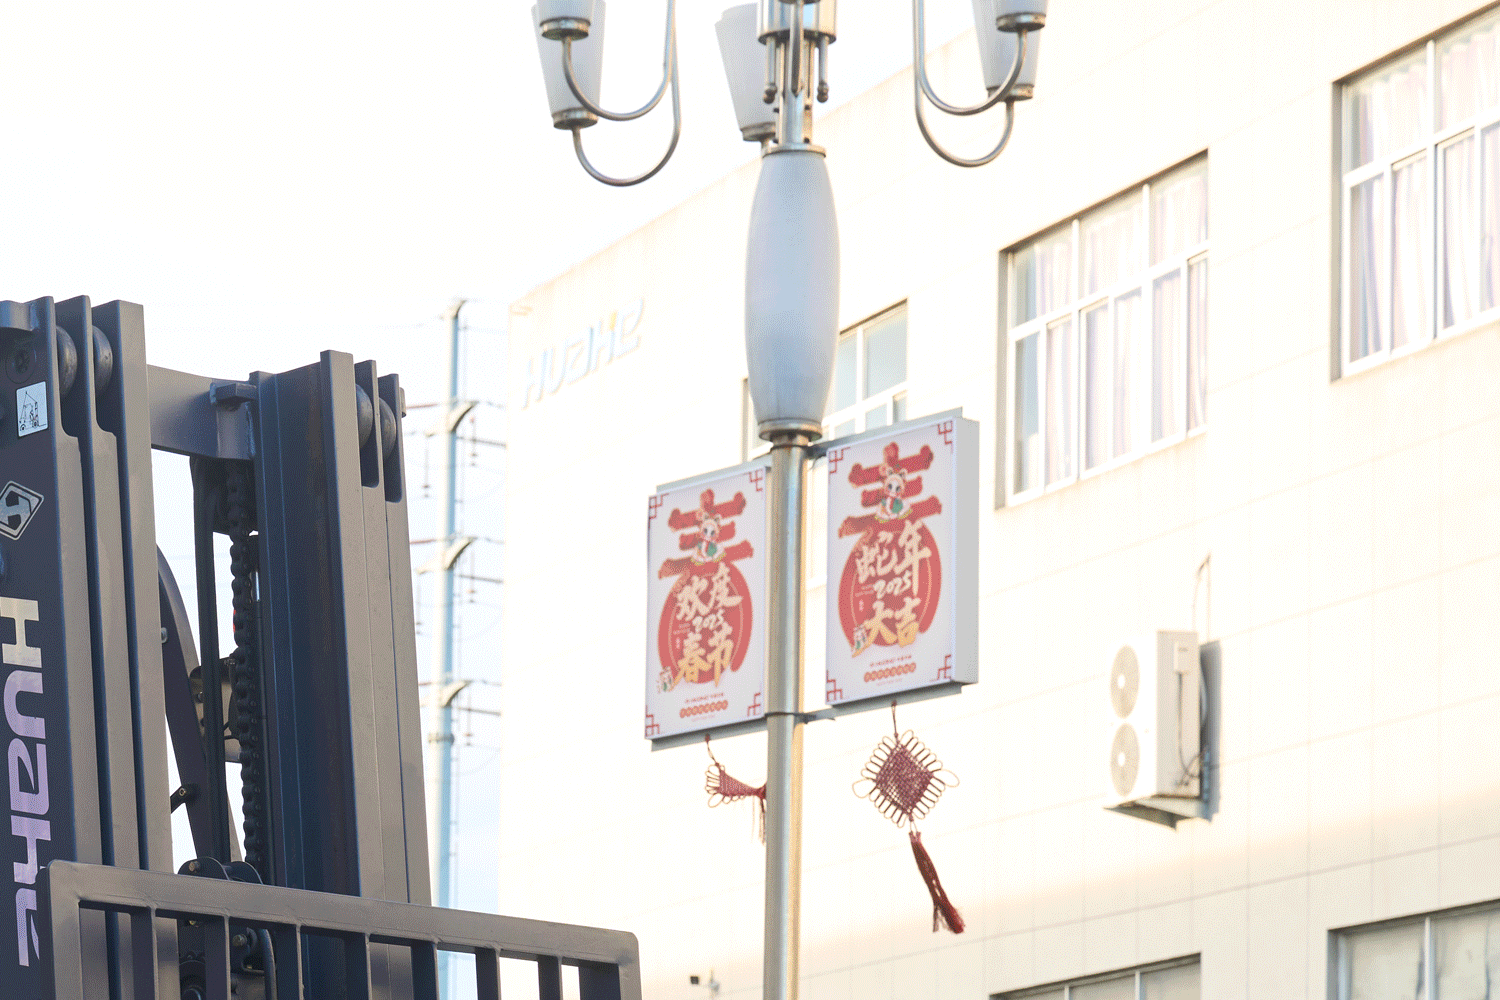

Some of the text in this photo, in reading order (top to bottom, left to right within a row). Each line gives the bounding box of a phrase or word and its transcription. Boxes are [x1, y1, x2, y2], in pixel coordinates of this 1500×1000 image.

[855, 519, 932, 597] 蛇年
[873, 570, 912, 599] 2025
[675, 561, 744, 622] 欢度
[691, 609, 726, 633] 2025
[669, 621, 734, 691] 春节
[851, 597, 922, 659] 大吉
